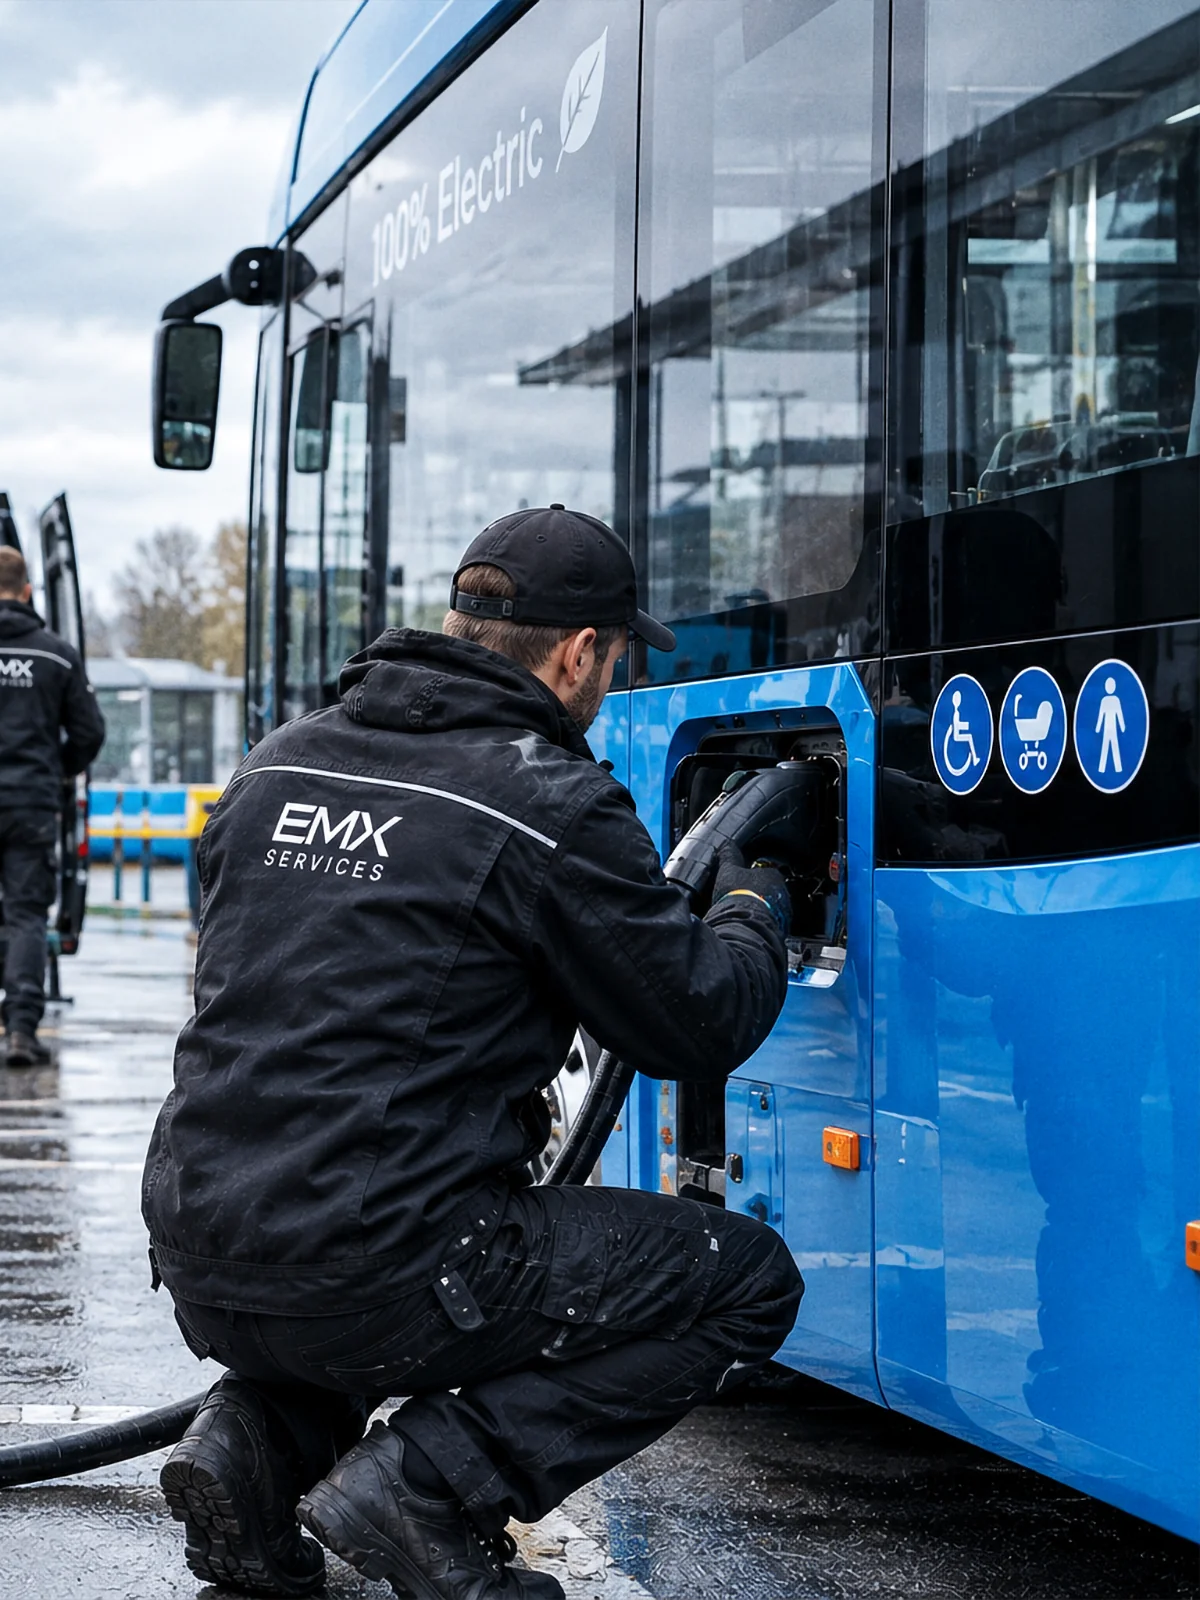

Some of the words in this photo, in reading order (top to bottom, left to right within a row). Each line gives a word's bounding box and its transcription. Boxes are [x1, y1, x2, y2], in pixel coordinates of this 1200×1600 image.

[372, 182, 430, 288] 100%
[437, 106, 543, 243] Electric
[272, 802, 403, 858] EMX
[264, 848, 384, 881] SERVICES
